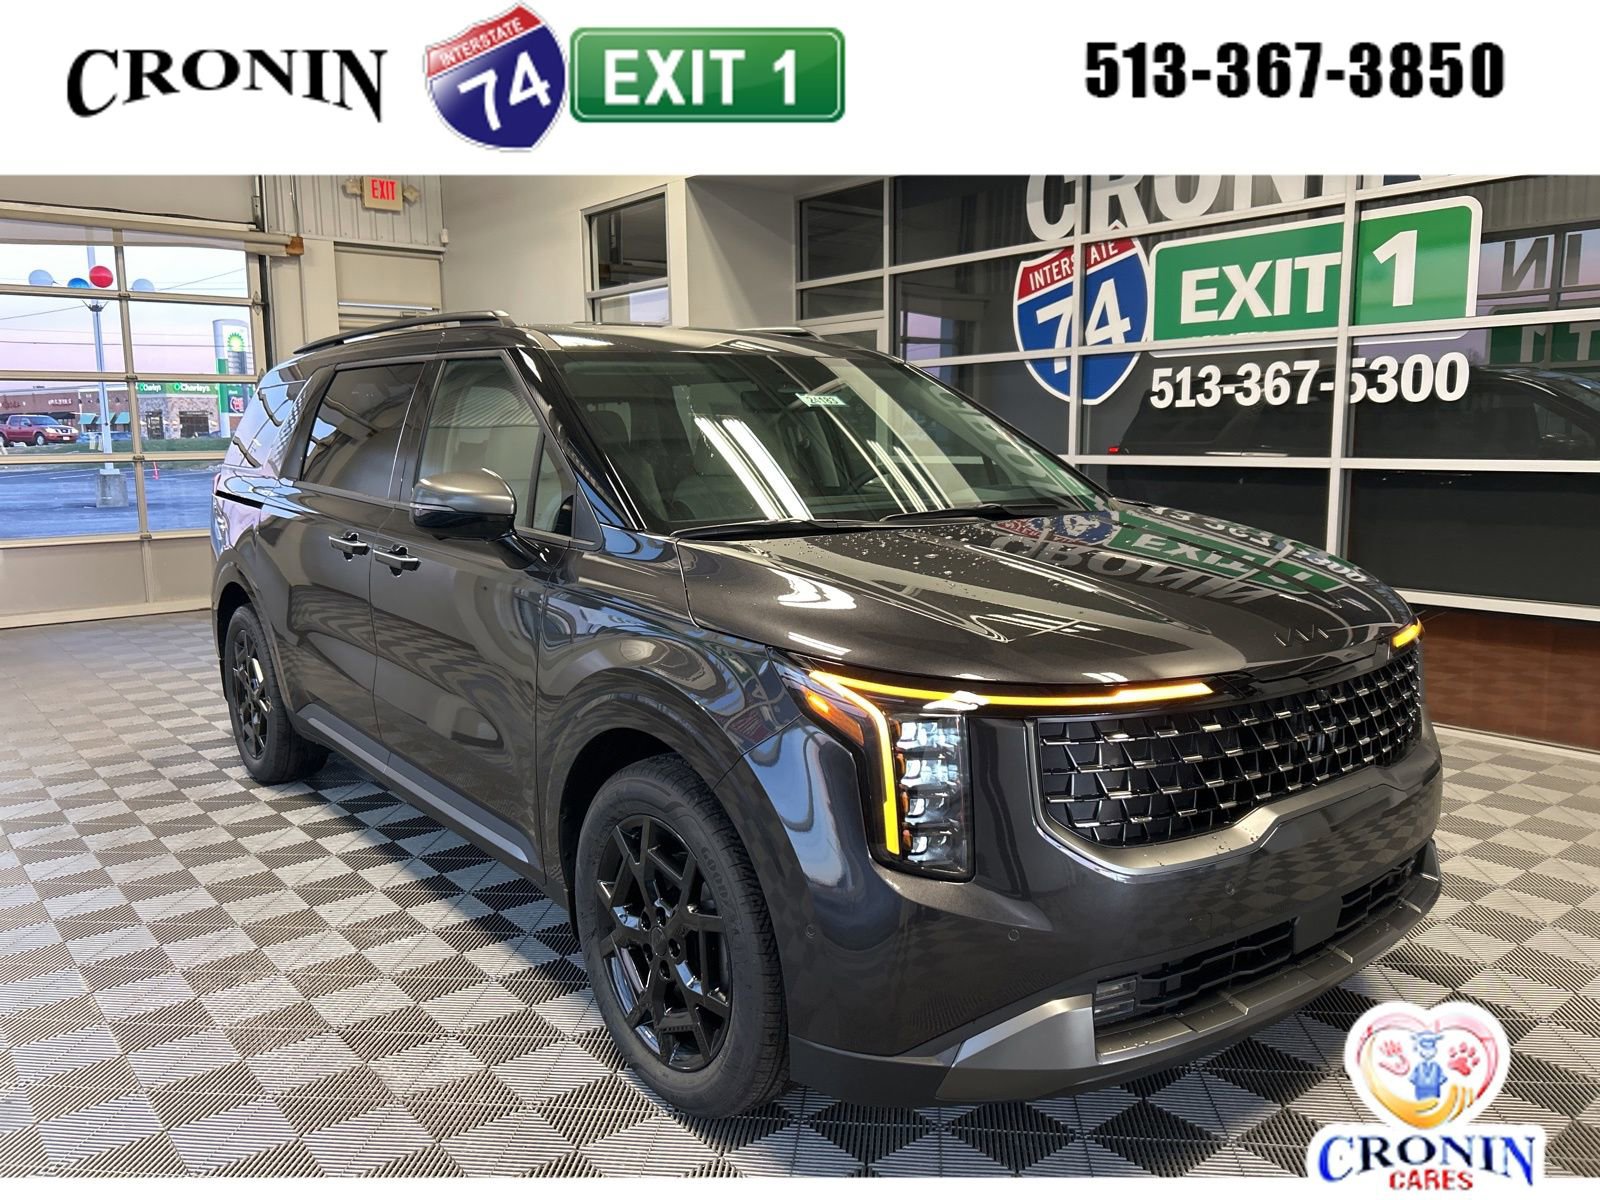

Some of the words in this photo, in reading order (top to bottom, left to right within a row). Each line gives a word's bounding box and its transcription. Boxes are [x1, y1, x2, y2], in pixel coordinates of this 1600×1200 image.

[370, 178, 396, 201] EXIT
[1180, 252, 1342, 324] EXIT
[1373, 230, 1418, 307] 1
[1036, 278, 1131, 374] 74
[1150, 352, 1470, 409] 513-367-5300
